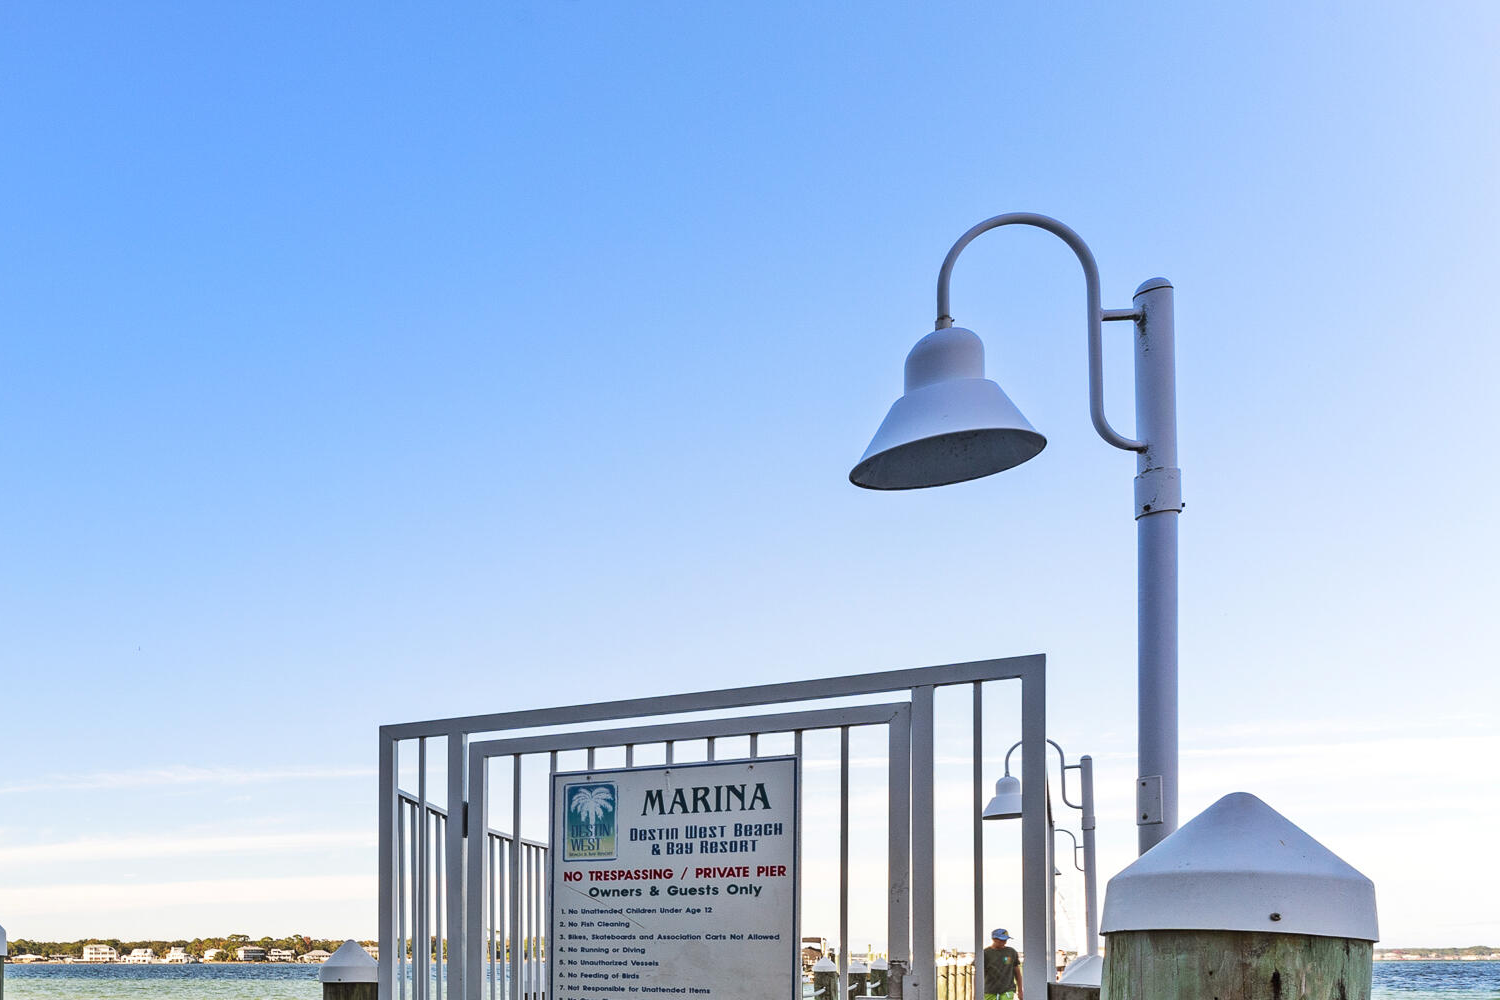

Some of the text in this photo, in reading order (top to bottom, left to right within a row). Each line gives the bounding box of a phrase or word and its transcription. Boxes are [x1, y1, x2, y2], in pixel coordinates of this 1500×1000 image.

[641, 783, 772, 816] MARINA
[571, 838, 602, 851] WEST
[652, 844, 661, 855] &
[564, 871, 583, 881] NO
[589, 868, 673, 881] TRESPASSING
[695, 866, 749, 879] PRIVATE
[757, 865, 786, 877] PIER
[589, 884, 762, 898] Owners & Guests Only
[685, 907, 701, 915] Age
[580, 972, 609, 980] Feeding
